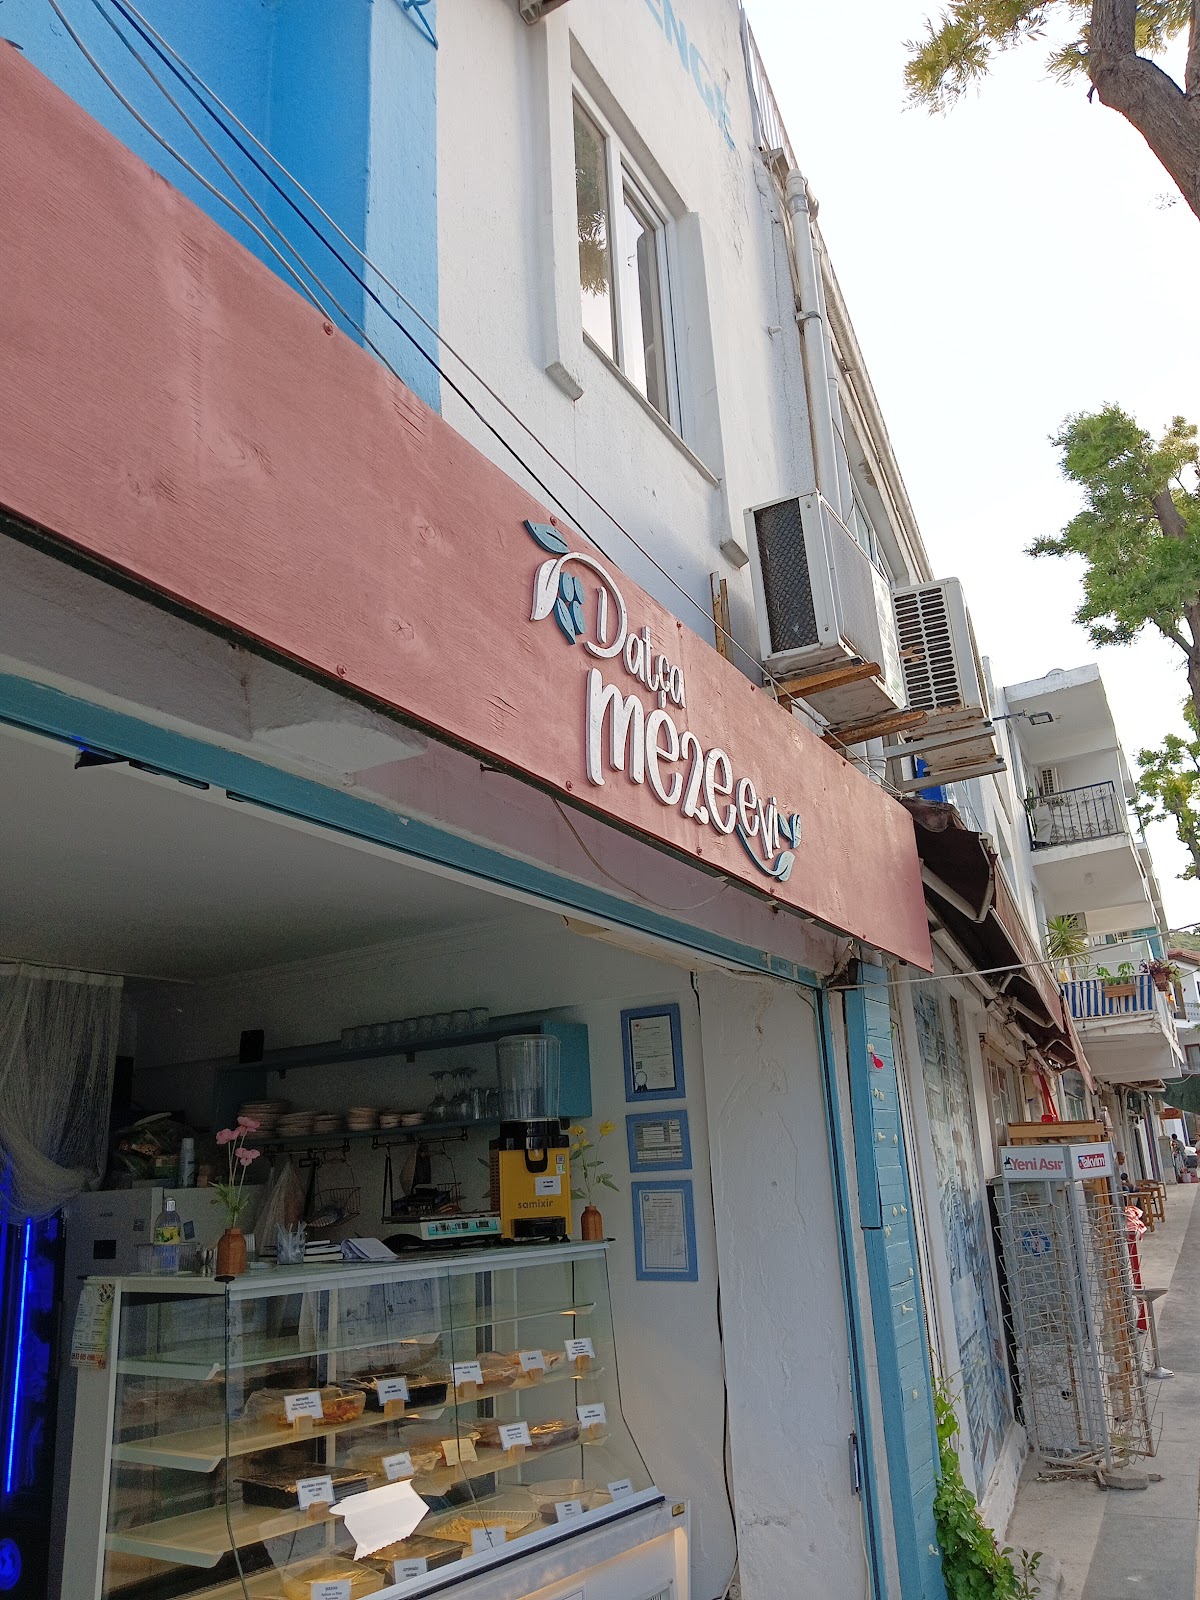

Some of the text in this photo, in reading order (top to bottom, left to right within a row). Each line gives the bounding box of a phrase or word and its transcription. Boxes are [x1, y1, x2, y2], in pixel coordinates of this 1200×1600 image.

[530, 551, 687, 709] Datça
[1011, 1158, 1063, 1171] Yeni Asır
[1079, 1154, 1106, 1169] Takvim
[517, 1198, 553, 1209] samixir
